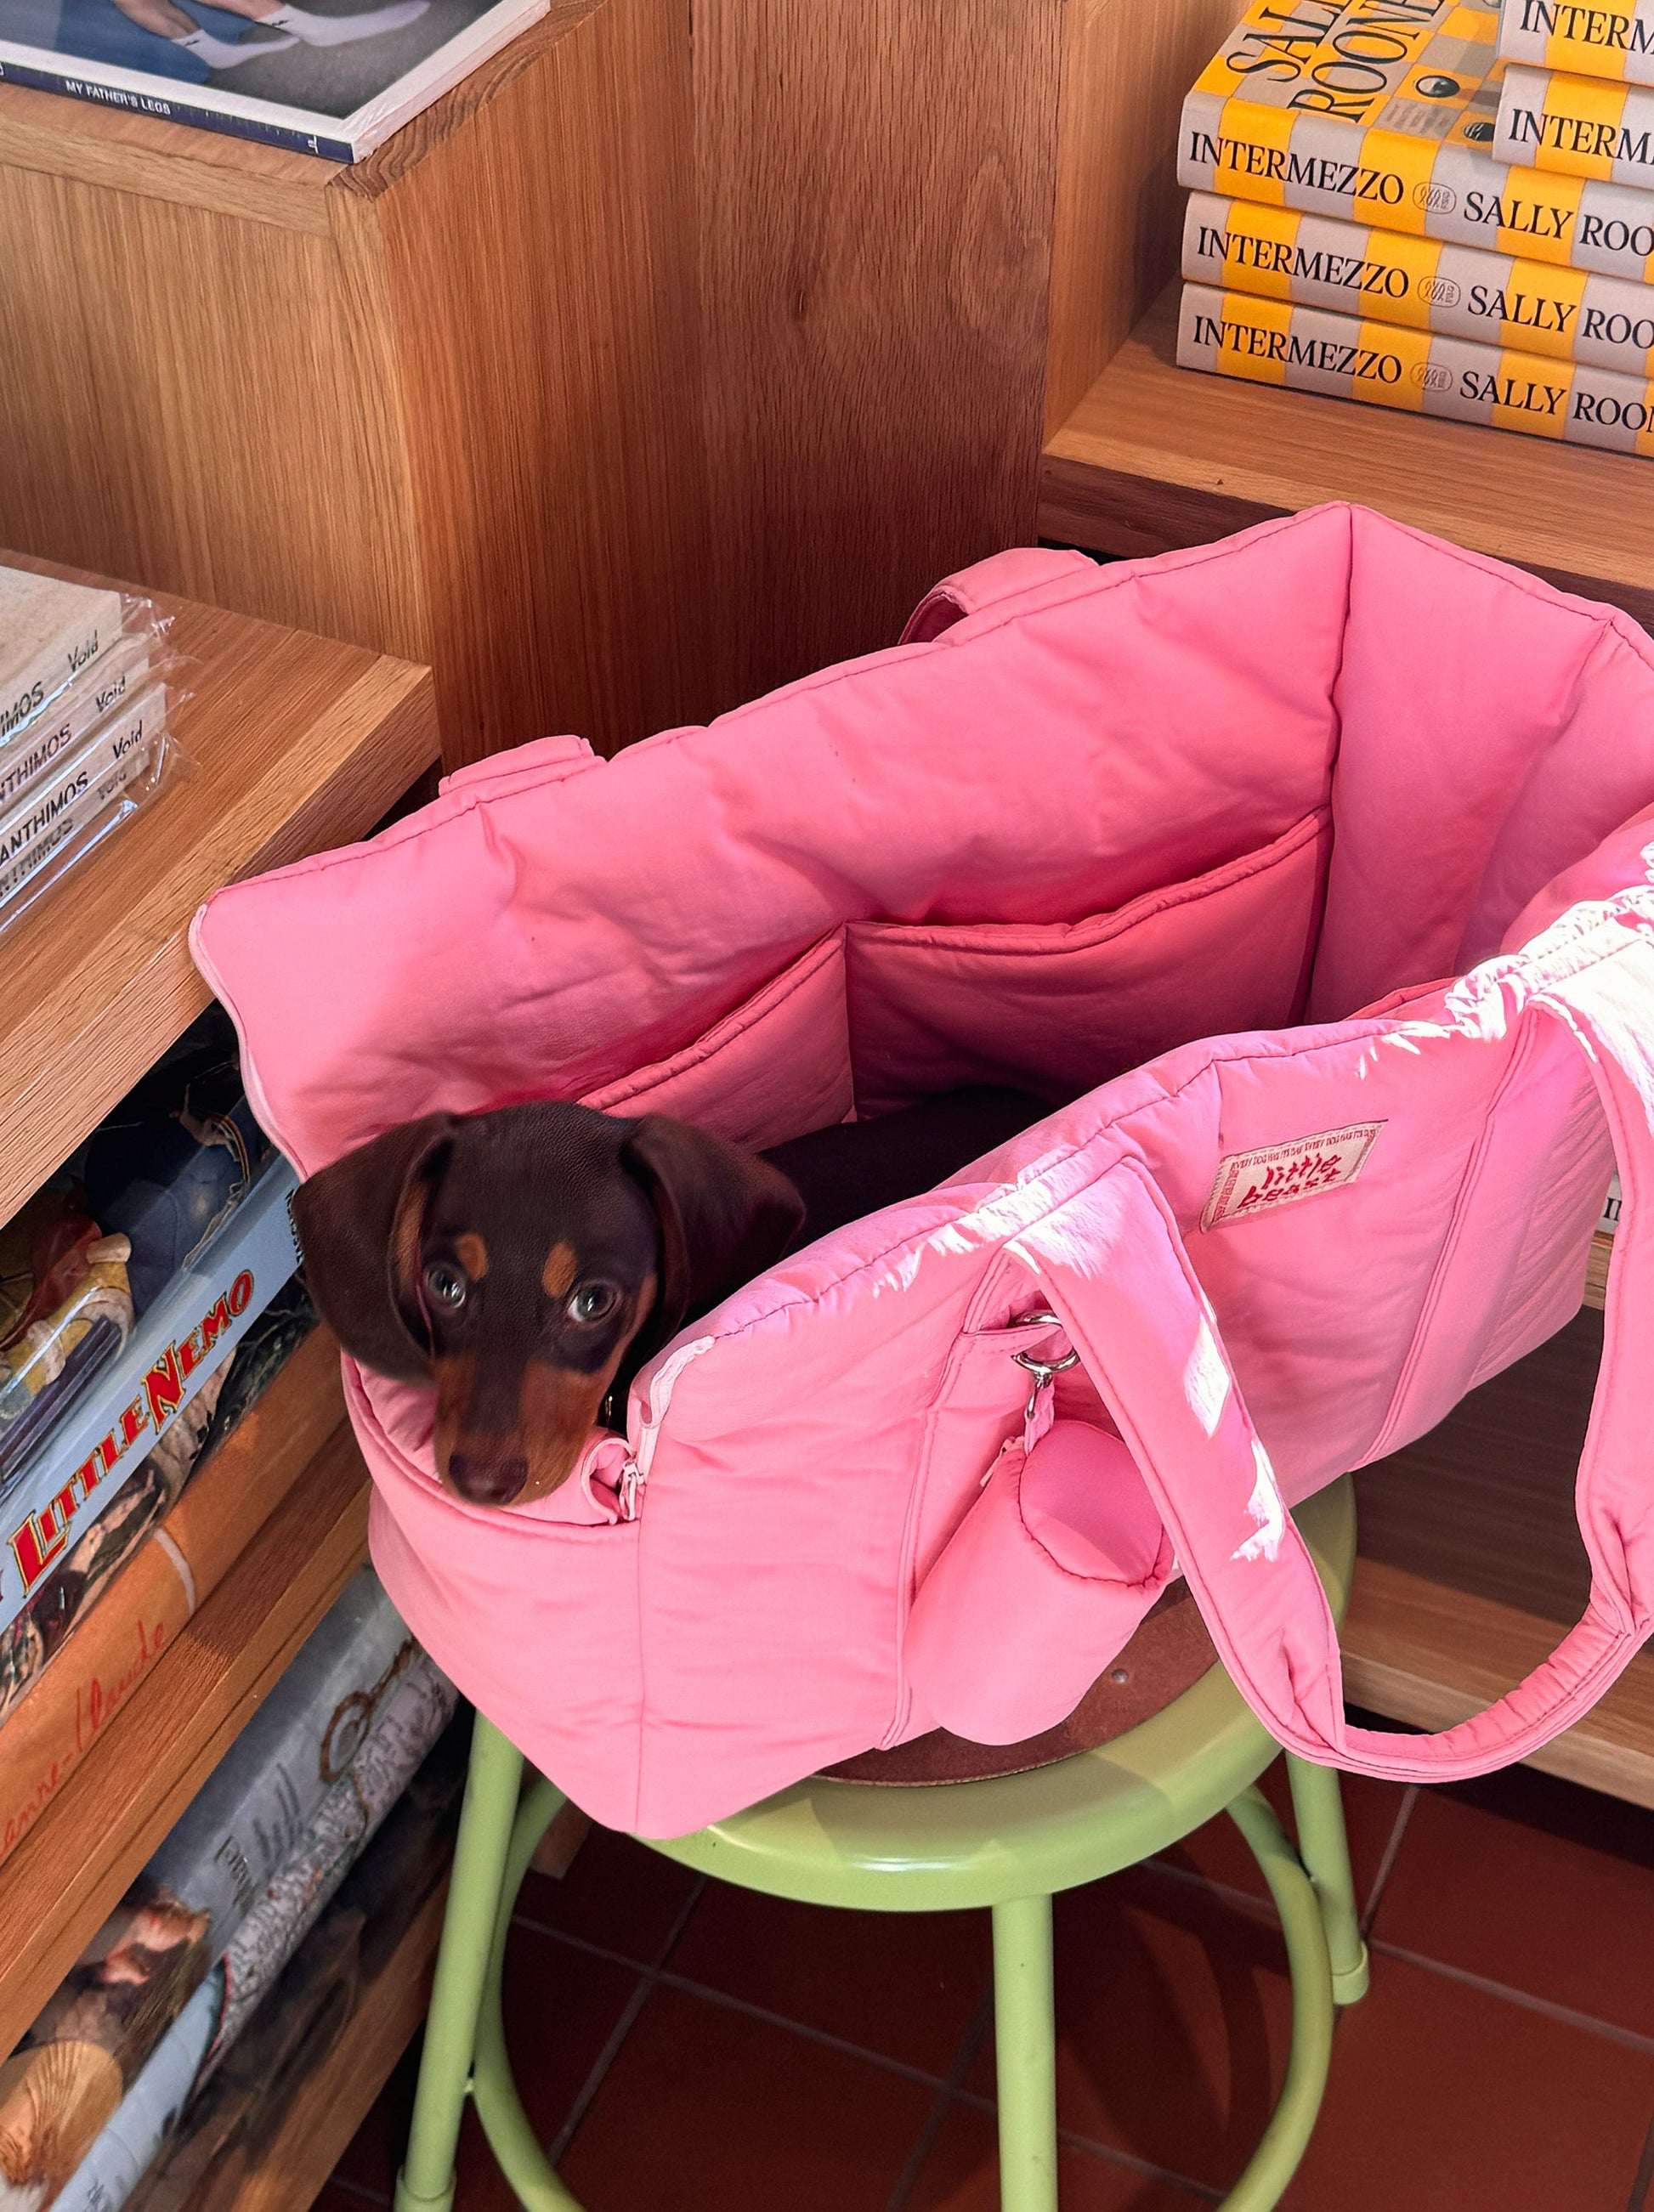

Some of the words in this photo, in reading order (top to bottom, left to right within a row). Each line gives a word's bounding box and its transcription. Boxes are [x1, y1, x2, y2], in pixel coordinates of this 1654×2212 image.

[1226, 0, 1352, 82] SAL
[65, 80, 83, 94] MY
[1509, 108, 1654, 165] INTERM
[1190, 132, 1404, 205] INTERMEZZO
[1464, 191, 1573, 239] SALLY
[1579, 214, 1654, 256] ROO
[1197, 226, 1408, 298] INTERMEZZO
[1468, 286, 1577, 332] SALLY
[1582, 308, 1654, 349] ROO
[1193, 316, 1402, 384] INTERMEZZO
[1459, 371, 1566, 416] SALLY
[0, 682, 44, 738] IMOS
[68, 630, 99, 672] Void
[96, 676, 126, 713] Void
[113, 720, 143, 759] Void
[1237, 1168, 1341, 1209] beast
[1261, 1152, 1342, 1190] little
[7, 1395, 151, 1599] LITTLE
[141, 1270, 255, 1434] NEMO
